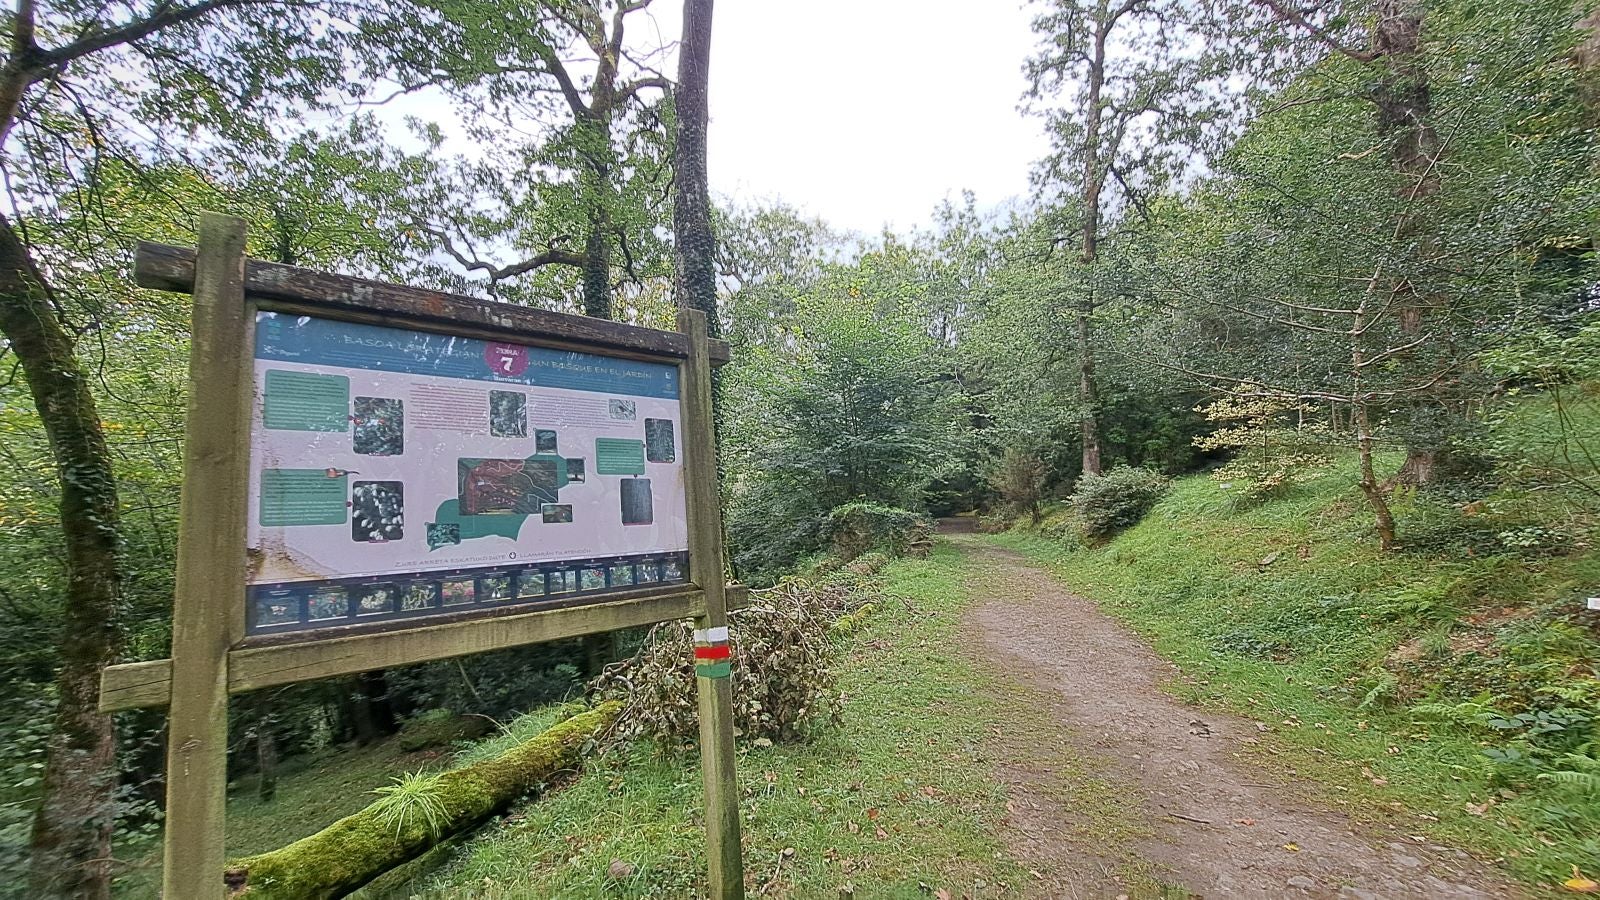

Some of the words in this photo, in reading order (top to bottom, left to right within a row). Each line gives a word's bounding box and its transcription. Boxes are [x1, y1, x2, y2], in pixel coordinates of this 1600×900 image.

[344, 336, 393, 349] BASOA
[501, 356, 513, 371] 7
[552, 361, 592, 373] BOSQUE
[595, 366, 607, 374] EN
[610, 368, 620, 376] EL
